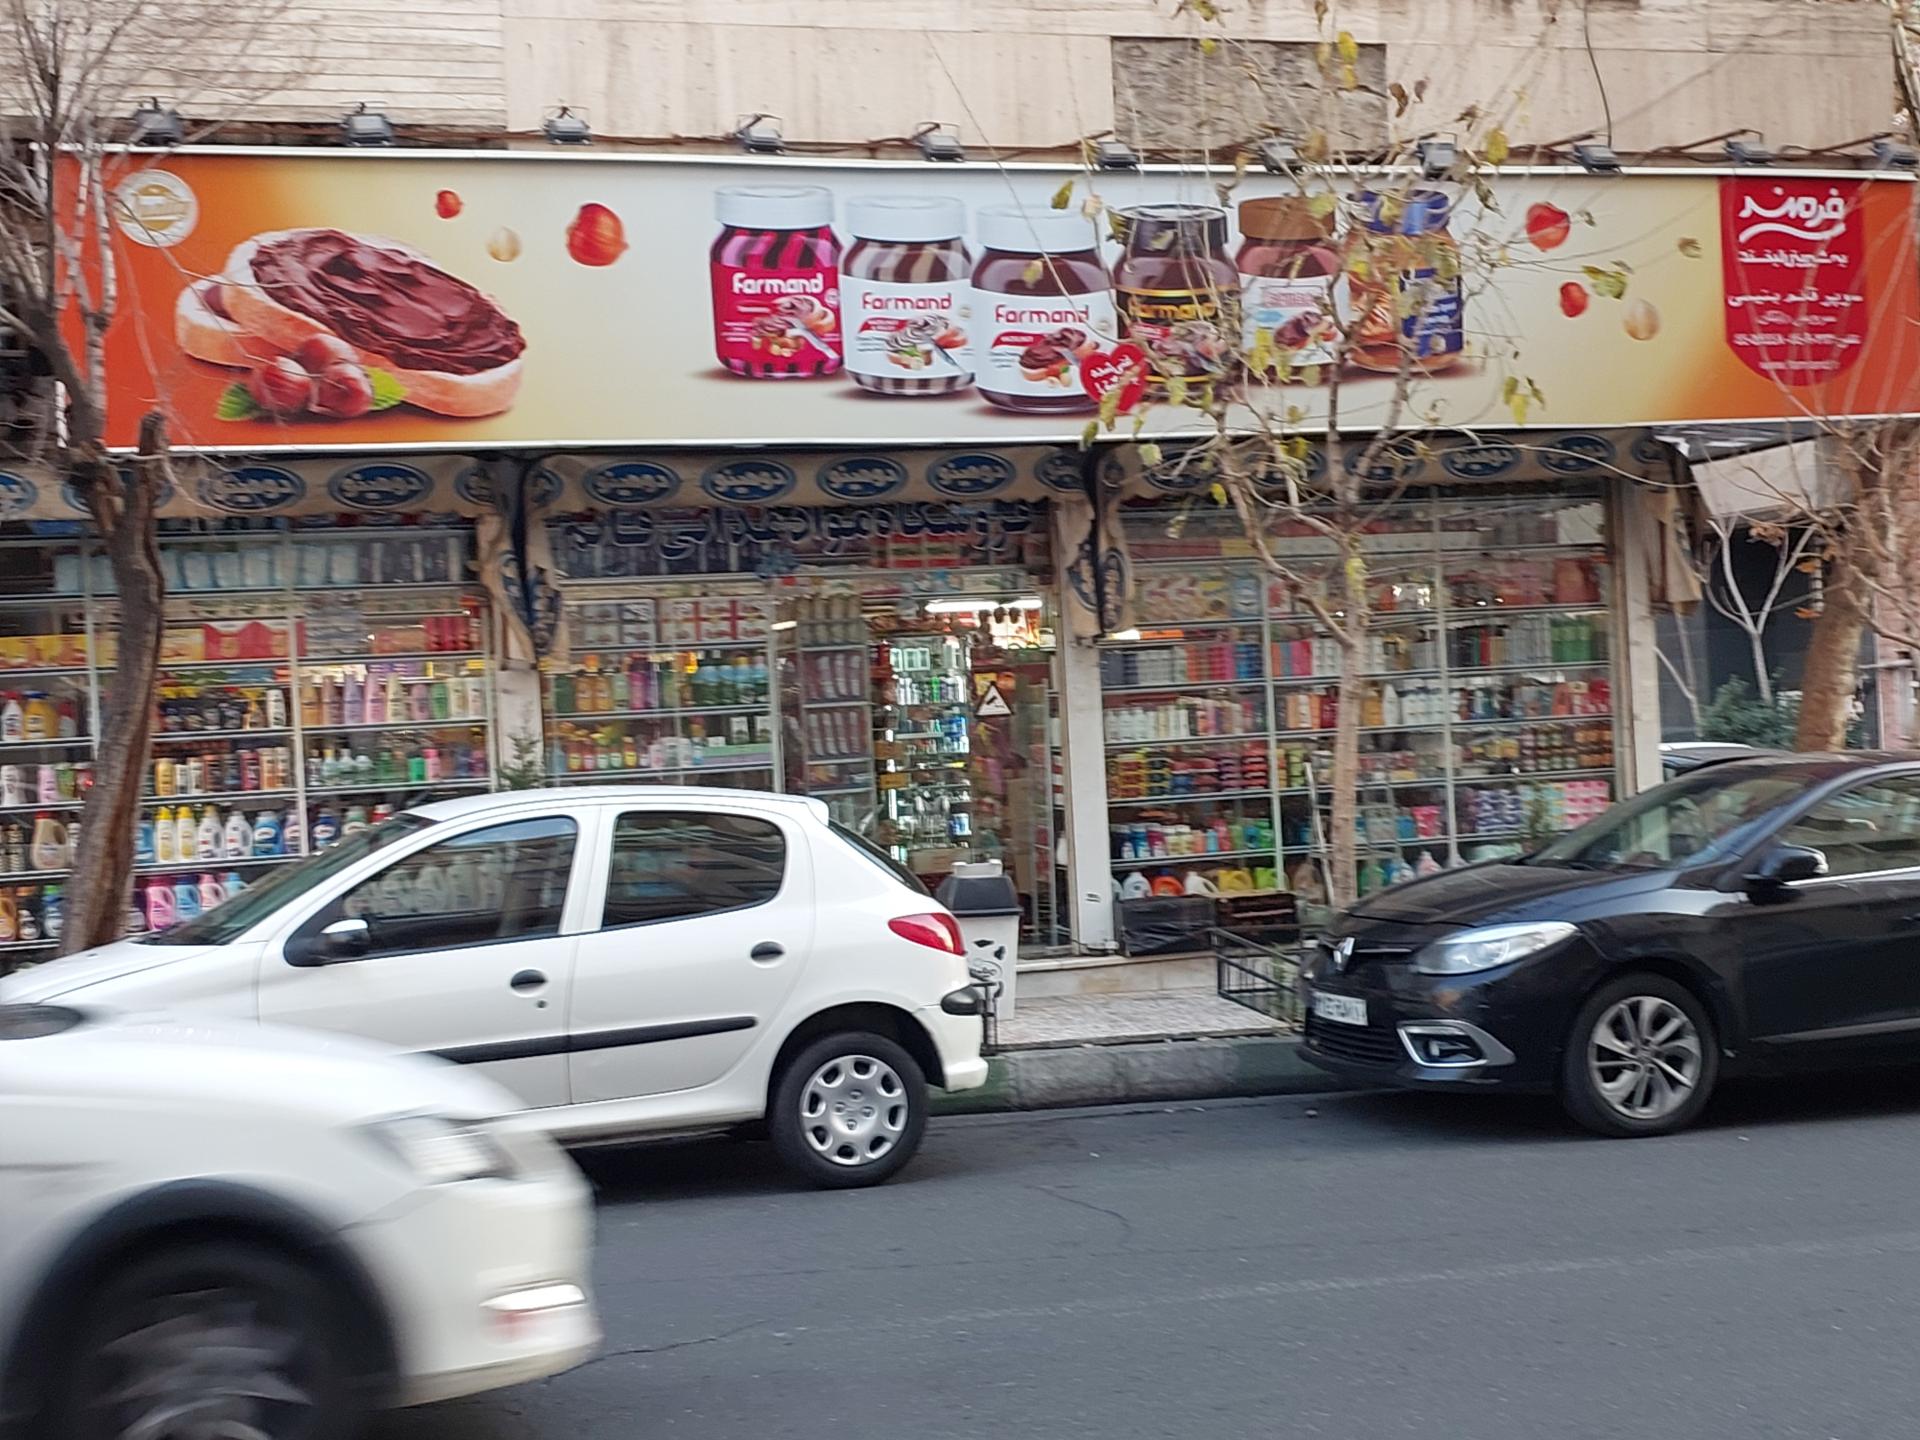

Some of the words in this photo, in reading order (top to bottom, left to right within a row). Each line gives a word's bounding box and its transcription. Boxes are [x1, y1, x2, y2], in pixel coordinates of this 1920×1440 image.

[1738, 186, 1846, 228] فرمند
[731, 271, 825, 295] Farmand
[861, 291, 953, 310] Farmand
[994, 303, 1090, 324] Farmand
